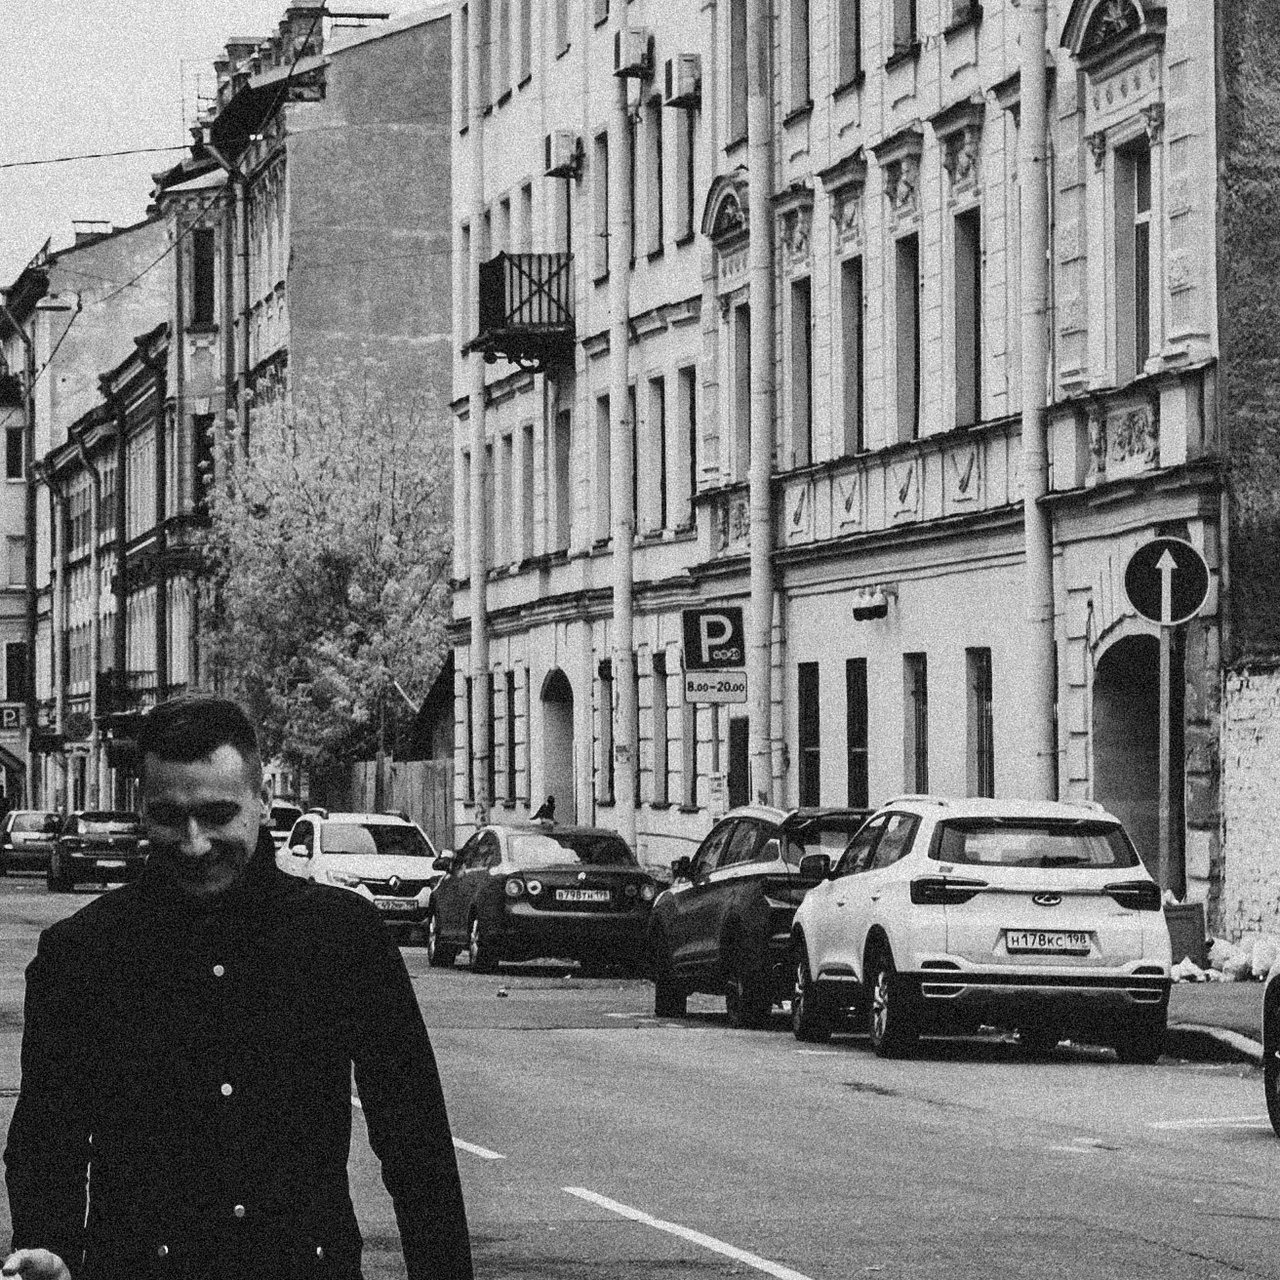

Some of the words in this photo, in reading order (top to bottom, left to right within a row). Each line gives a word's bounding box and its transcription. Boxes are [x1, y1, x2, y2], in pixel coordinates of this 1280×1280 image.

[699, 614, 733, 663] P
[3, 709, 16, 727] P
[1067, 933, 1087, 944] 198
